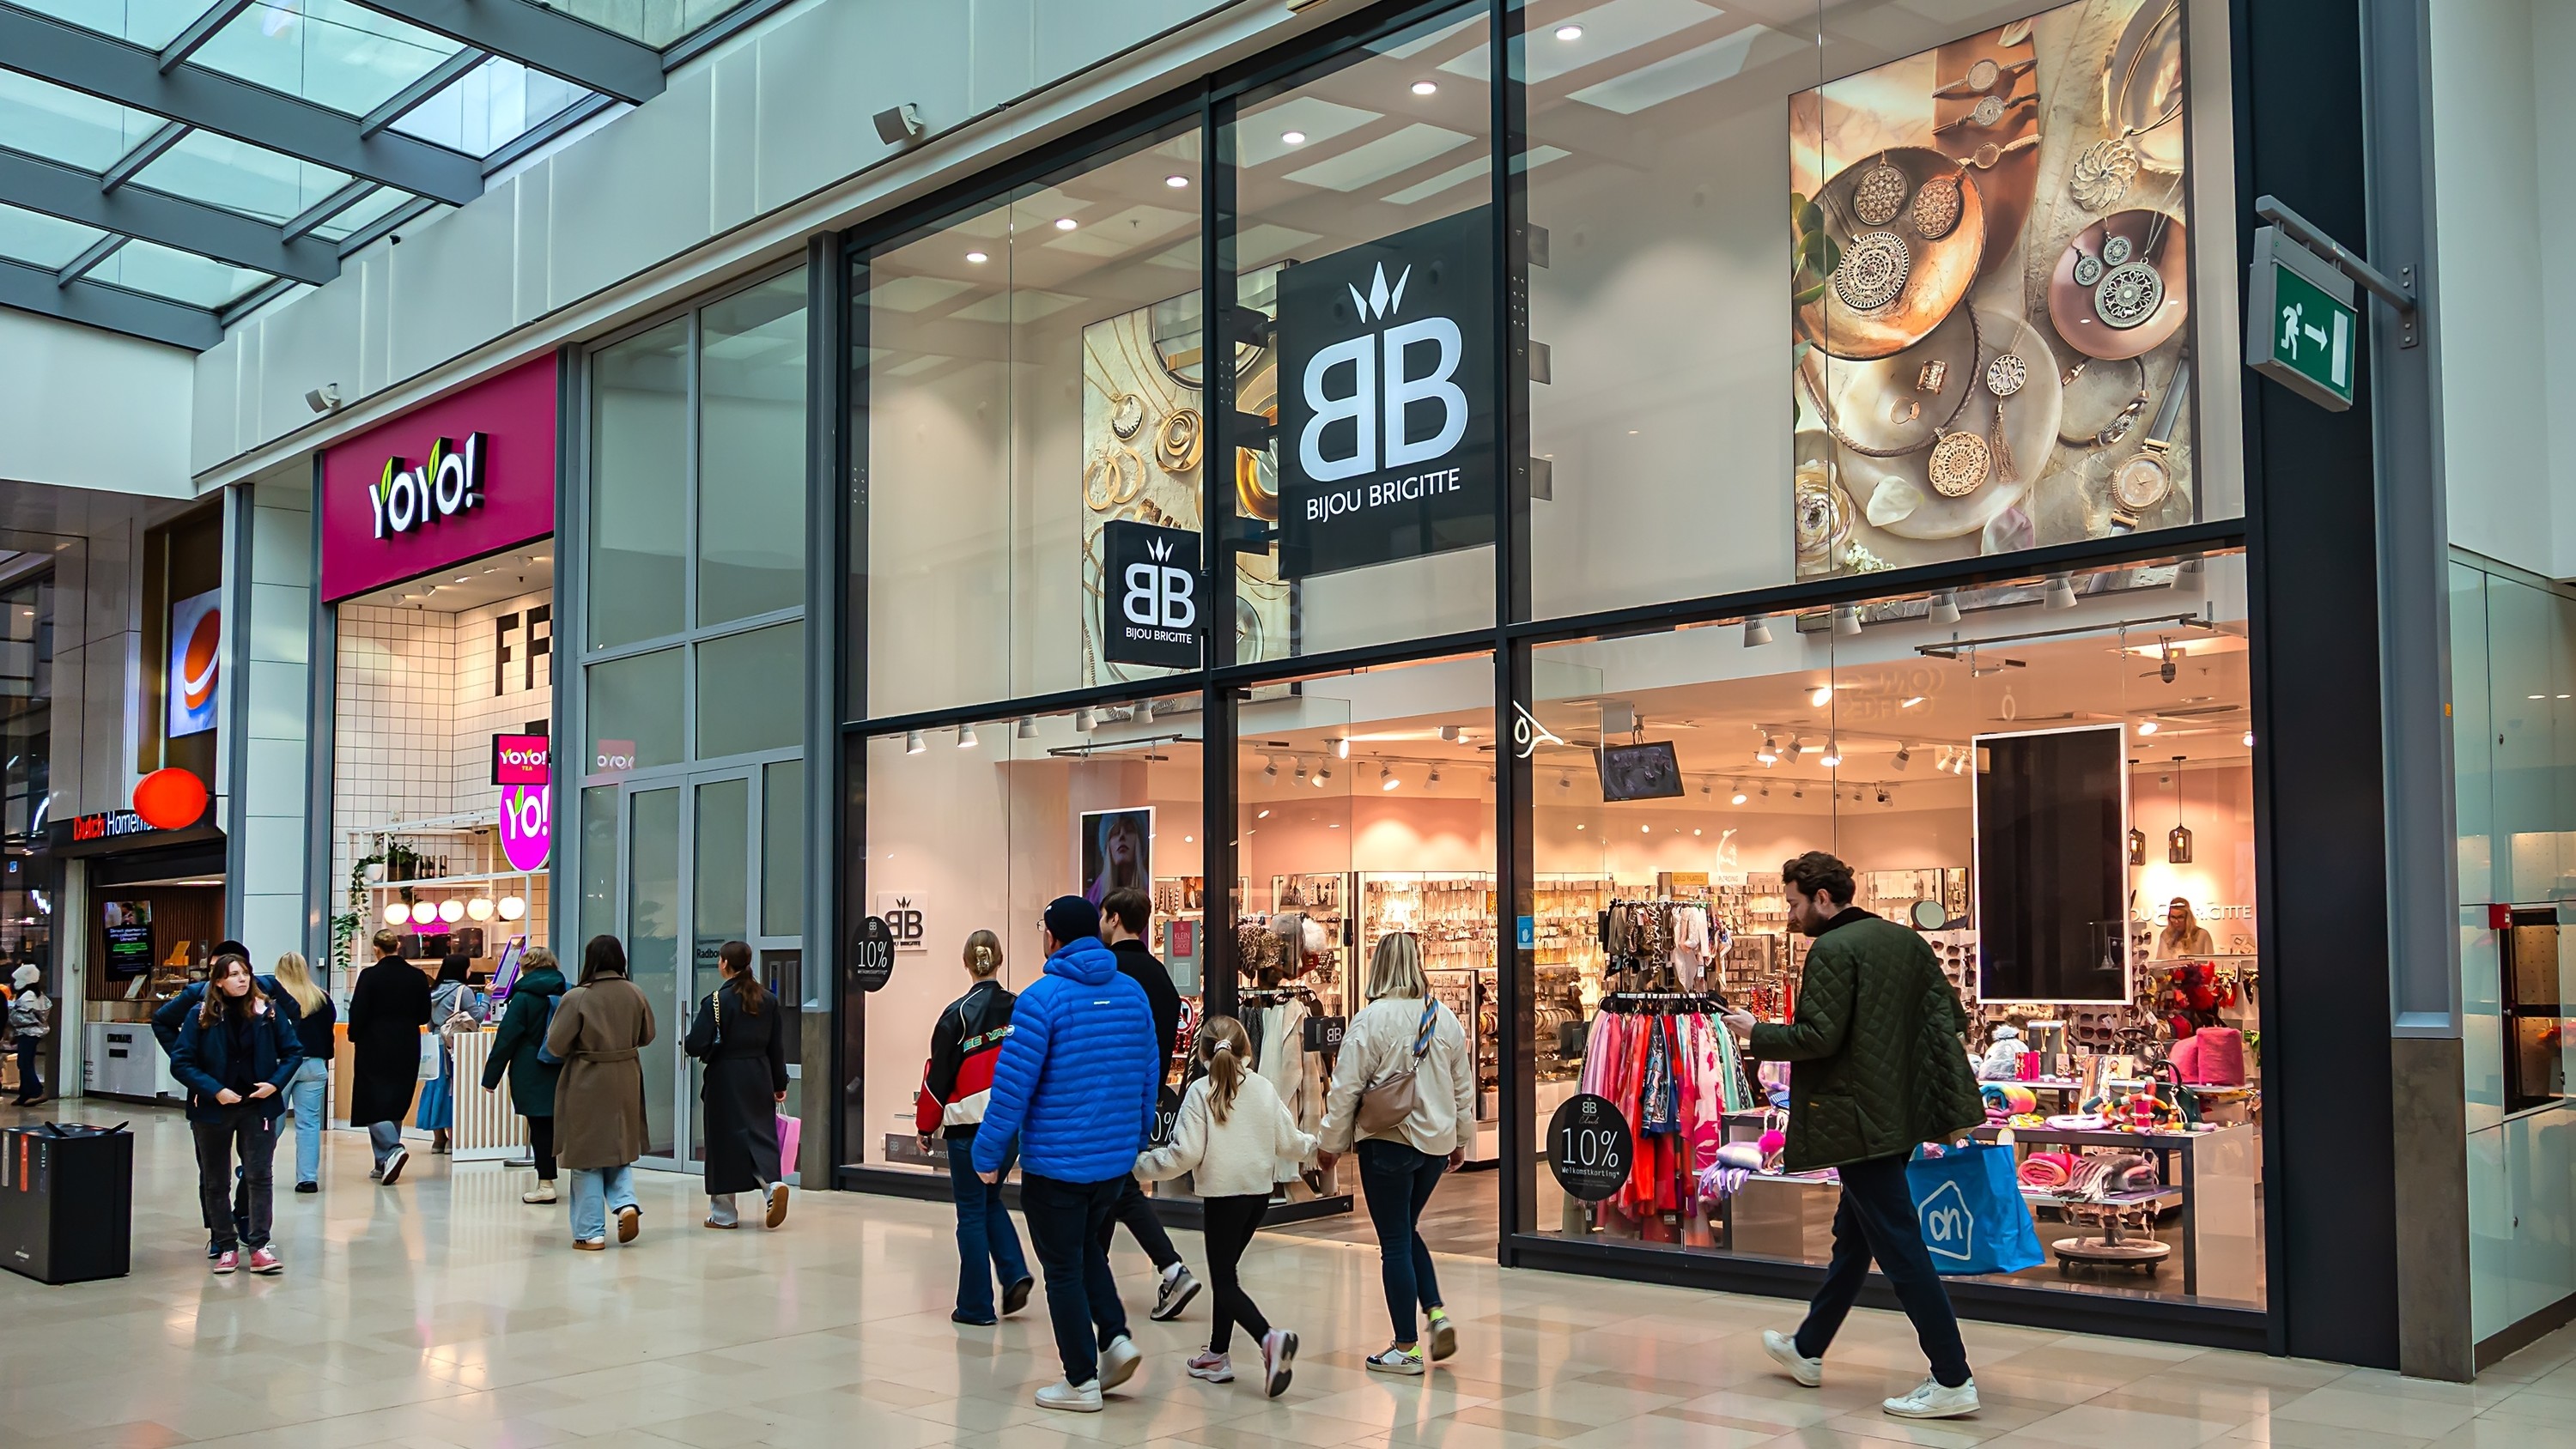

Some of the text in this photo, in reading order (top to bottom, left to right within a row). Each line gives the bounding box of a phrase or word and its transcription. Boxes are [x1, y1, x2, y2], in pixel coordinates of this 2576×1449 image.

[1299, 317, 1468, 482] BB
[368, 432, 477, 539] YOYO!
[1307, 467, 1461, 523] BIJOU BRIGITTE
[1123, 562, 1196, 628] BB
[1126, 627, 1193, 644] BIJOU BRIGITTE
[500, 749, 548, 765] YOYO!
[74, 813, 105, 841] Dutch
[505, 784, 550, 840] YO!
[858, 941, 888, 967] 10%
[1563, 1127, 1619, 1167] 10%
